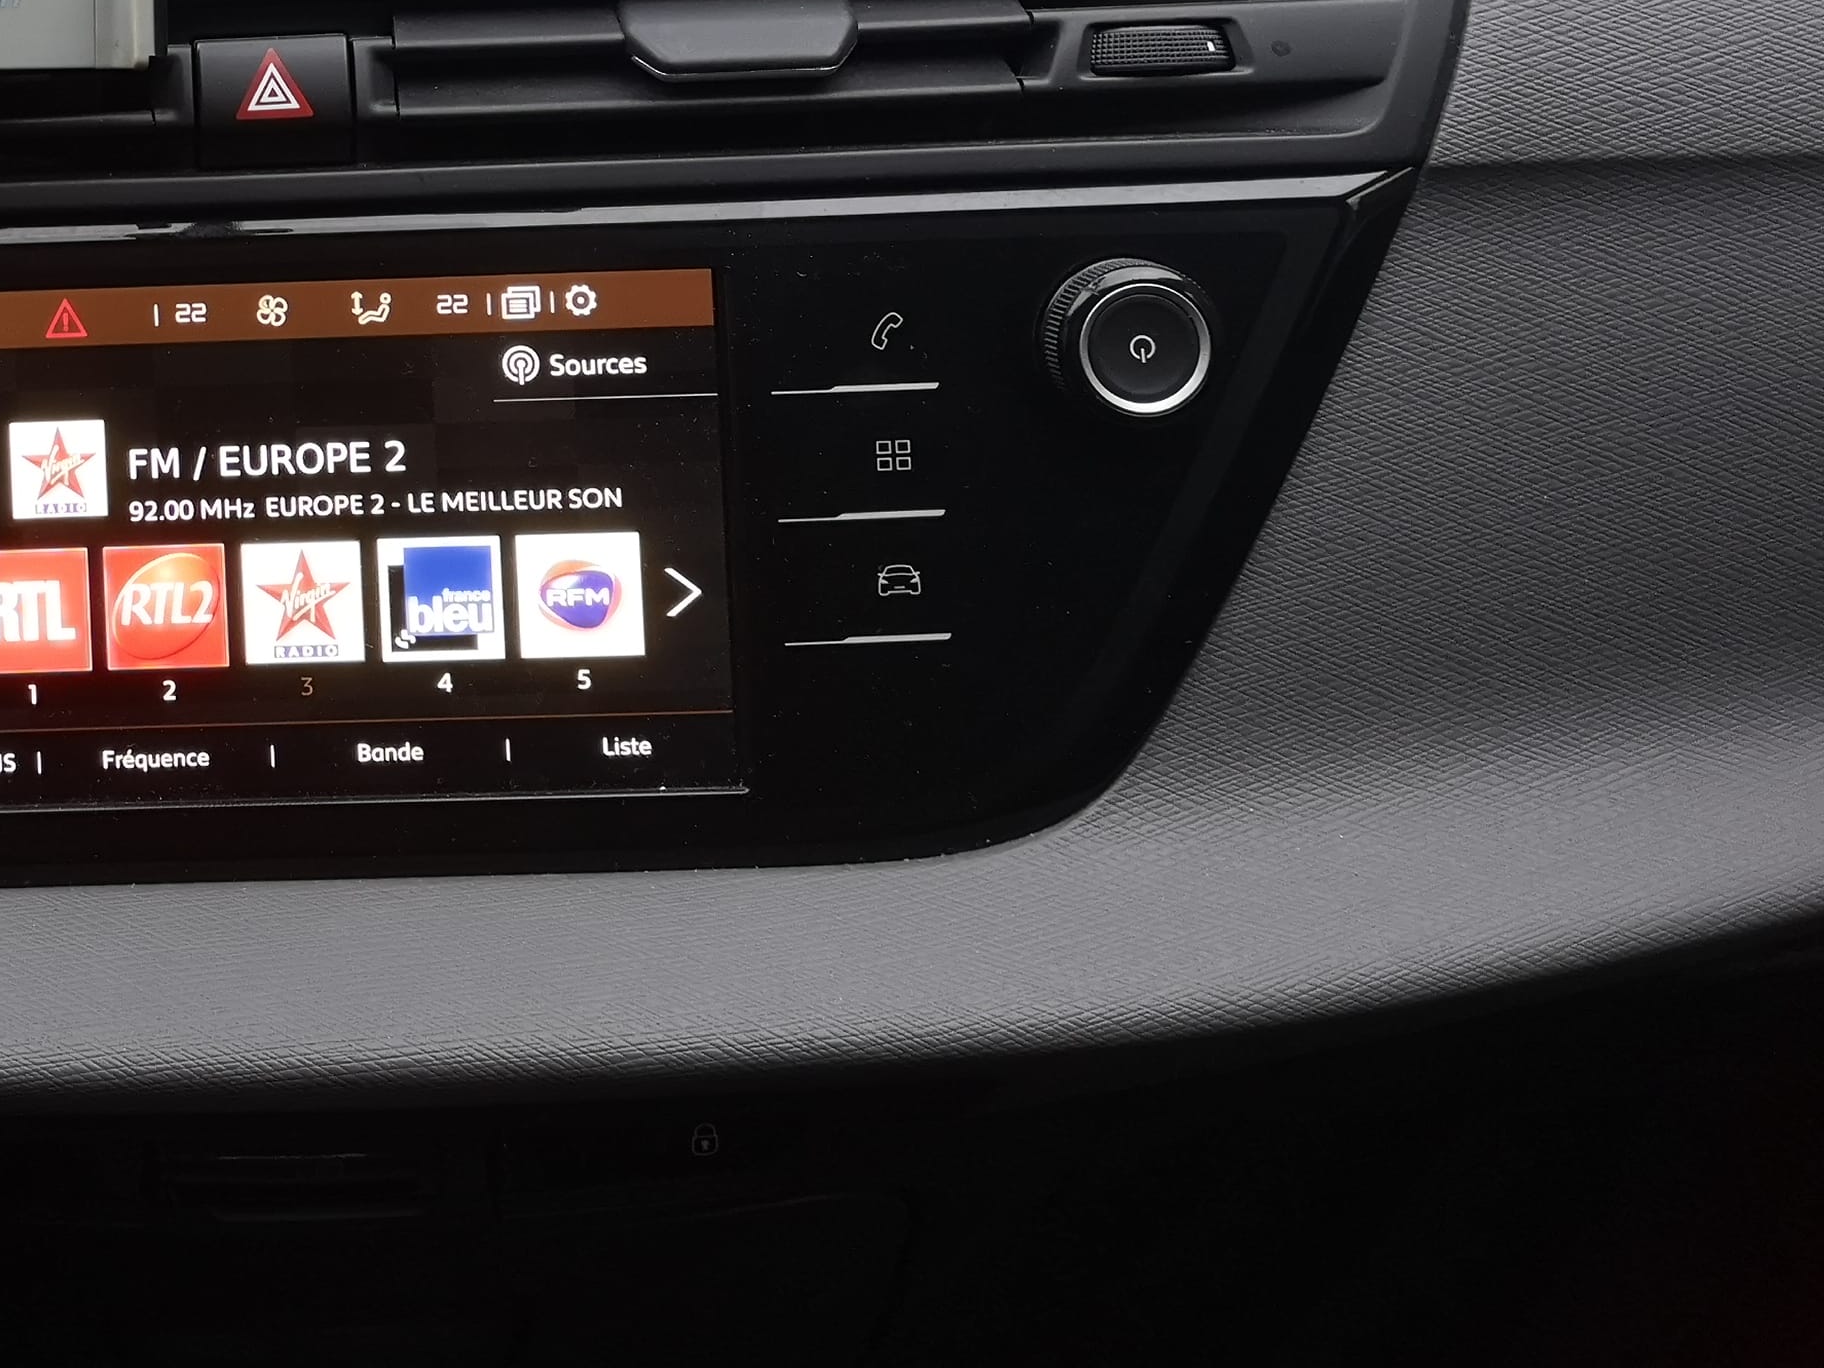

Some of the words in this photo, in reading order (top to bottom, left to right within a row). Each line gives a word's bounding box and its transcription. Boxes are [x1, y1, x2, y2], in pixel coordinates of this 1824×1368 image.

[175, 302, 207, 324] 22
[436, 293, 468, 315] 22
[549, 353, 648, 376] Sources
[129, 447, 180, 480] FM
[219, 442, 372, 477] EUROPE
[384, 440, 407, 472] 2
[129, 500, 195, 522] 92.00
[200, 498, 255, 519] MHz
[265, 494, 364, 518] EUROPE
[370, 493, 385, 515] 2
[408, 491, 435, 513] LE
[442, 488, 563, 512] MEILLEUR
[568, 487, 623, 509] SON
[120, 580, 216, 627] RTL2
[280, 572, 337, 622] Virgin
[442, 588, 491, 603] france
[545, 587, 610, 607] RFM
[408, 595, 494, 633] bleu
[275, 645, 339, 658] RADIO
[161, 680, 177, 701] 2
[301, 676, 314, 696] 3
[437, 672, 453, 693] 4
[577, 669, 592, 690] 5
[27, 683, 38, 704] 1
[357, 741, 424, 763] Bande
[602, 735, 652, 757] Liste
[101, 748, 210, 772] Fréquence
